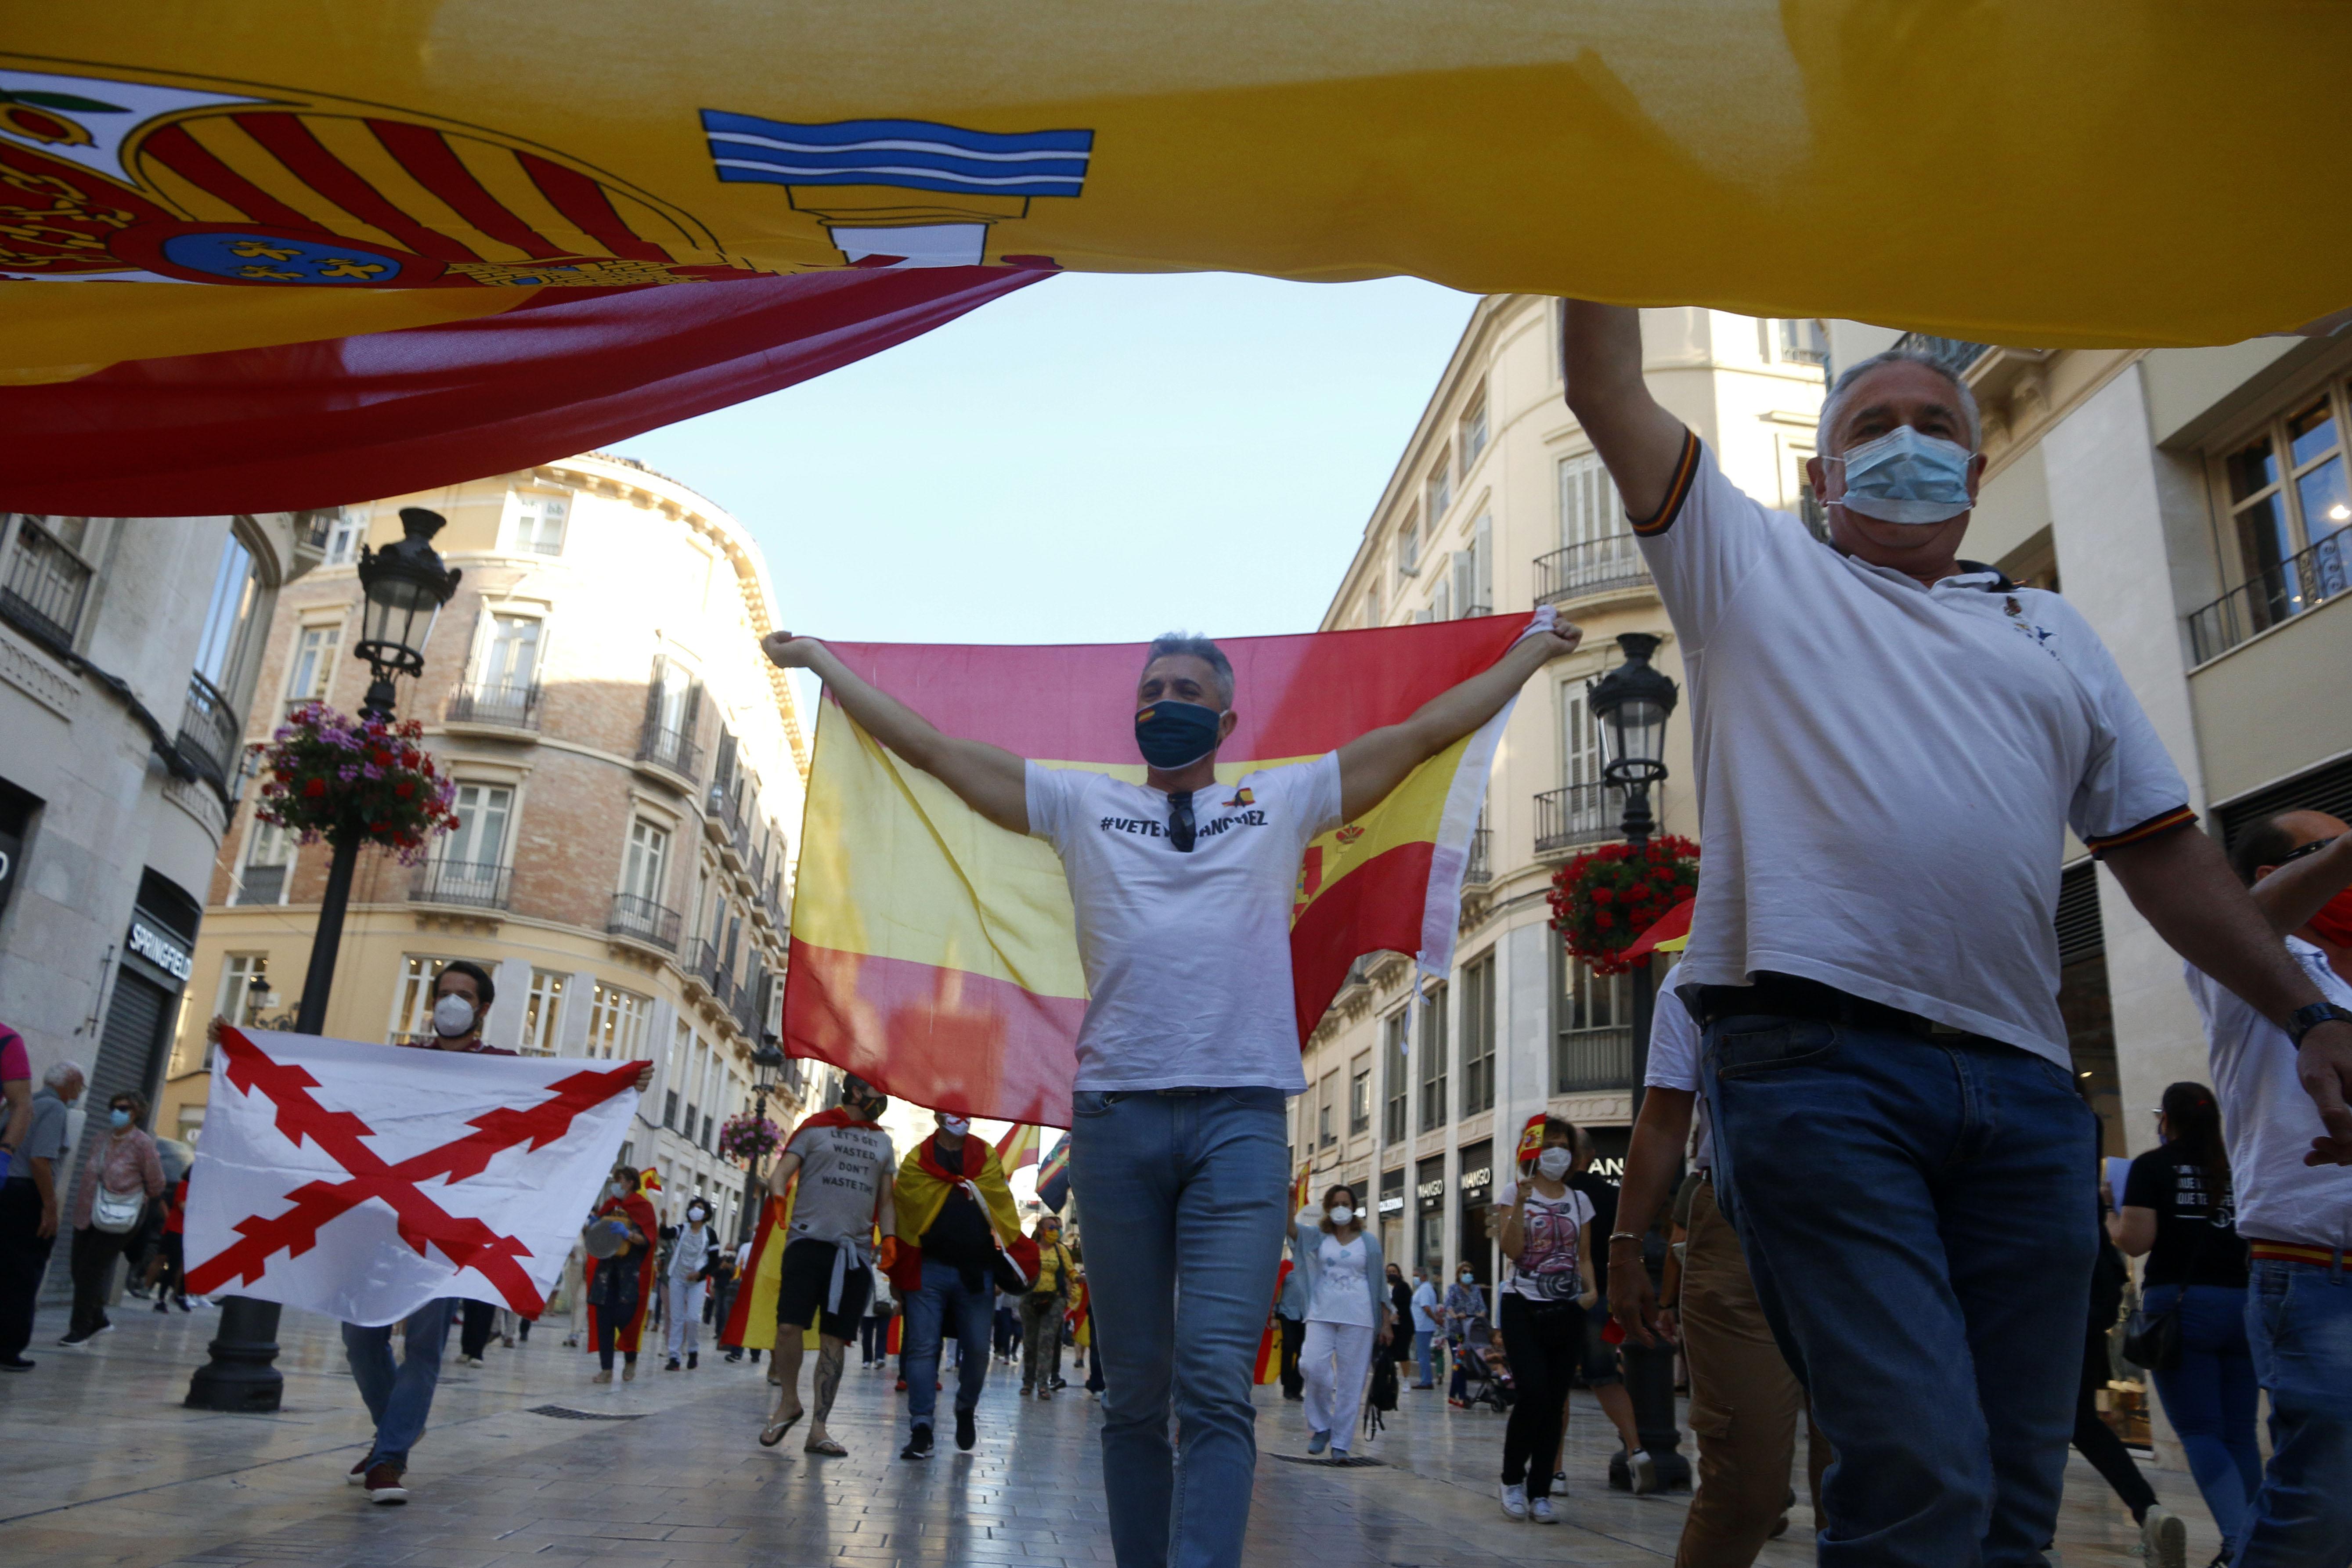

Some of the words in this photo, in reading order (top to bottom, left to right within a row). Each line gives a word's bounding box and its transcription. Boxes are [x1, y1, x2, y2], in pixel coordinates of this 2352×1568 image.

[130, 923, 192, 981] SPRINGFIELD
[862, 1137, 877, 1147] GET
[822, 1177, 857, 1189] WASTE
